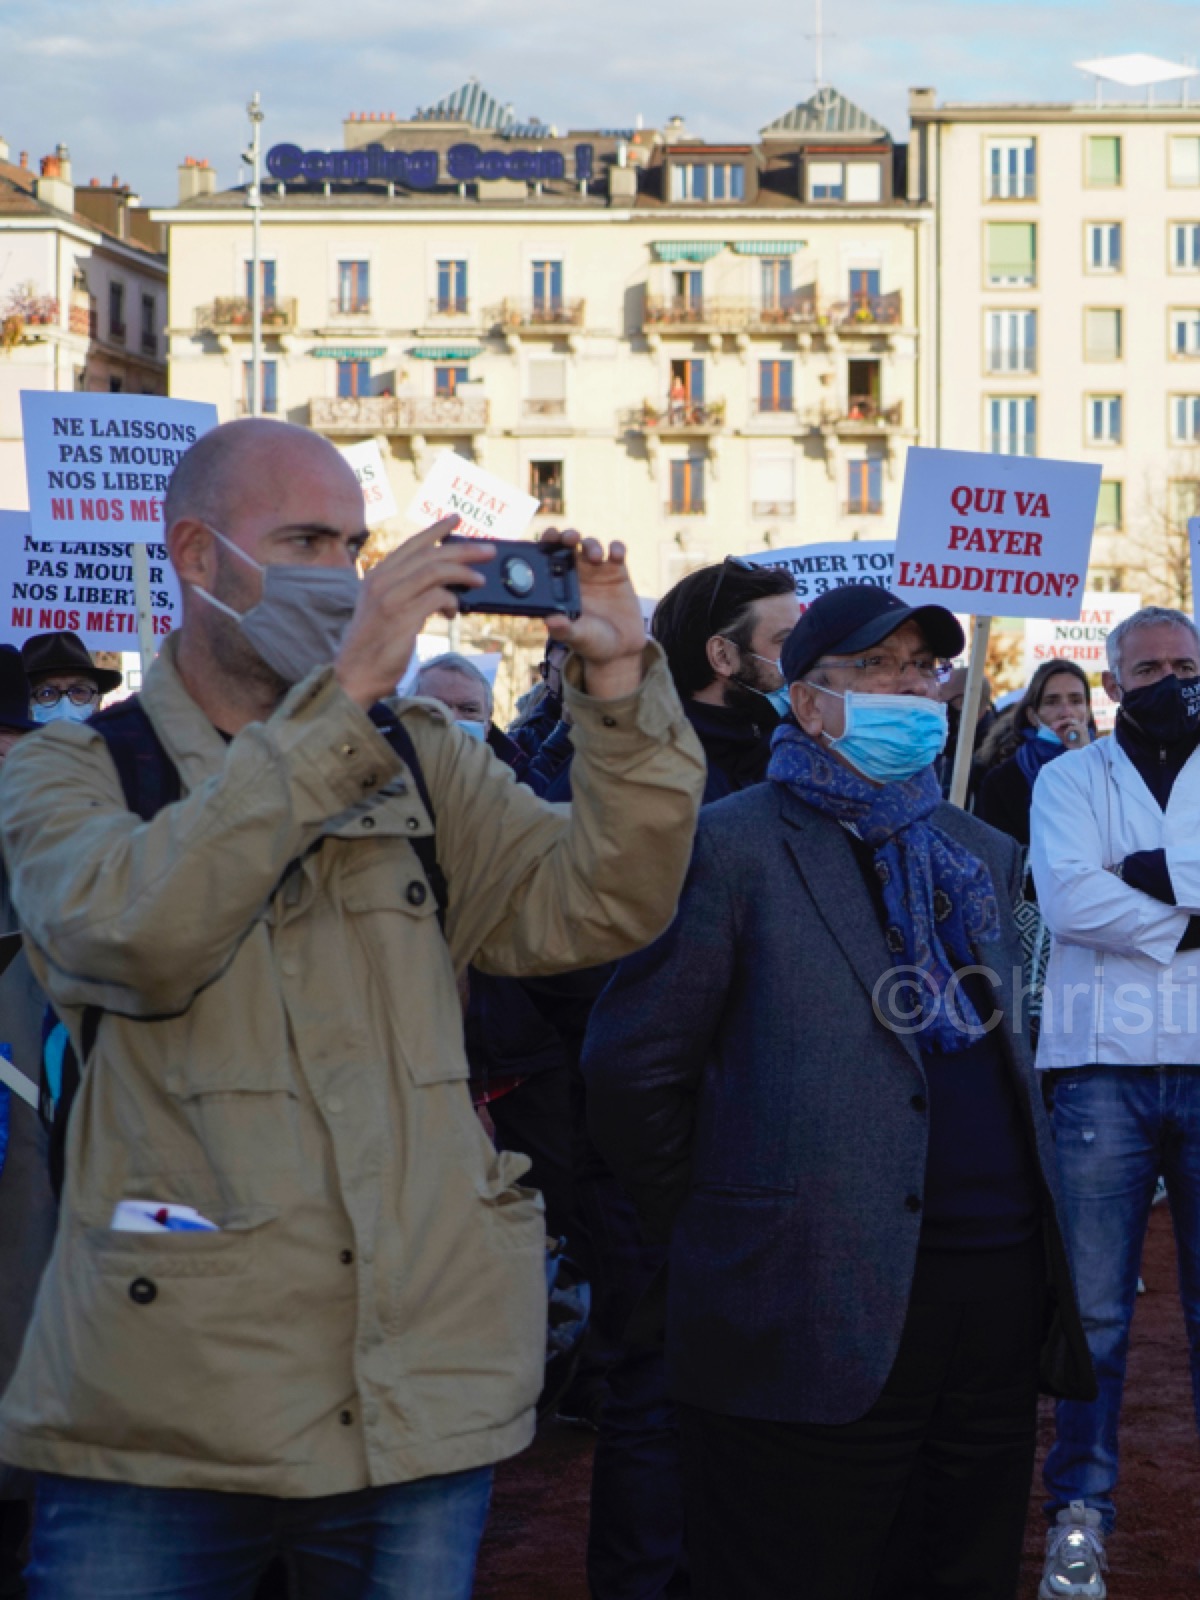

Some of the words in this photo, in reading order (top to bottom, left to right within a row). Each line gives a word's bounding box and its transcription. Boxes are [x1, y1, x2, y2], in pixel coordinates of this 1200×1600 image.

[52, 417, 84, 437] NE
[90, 419, 197, 443] LAISSONS
[58, 443, 103, 464] PAS
[47, 470, 96, 489] NOS
[51, 498, 74, 521] NI
[80, 498, 125, 522] NOS
[448, 493, 497, 528] NOUS
[951, 485, 1006, 517] QUI
[1014, 491, 1051, 518] VA
[948, 525, 1043, 557] PAYER
[26, 559, 69, 578] PAS
[898, 561, 1079, 598] L'ADDITION?
[12, 582, 58, 601] NOS
[12, 607, 33, 627] NI
[39, 608, 80, 630] NOS
